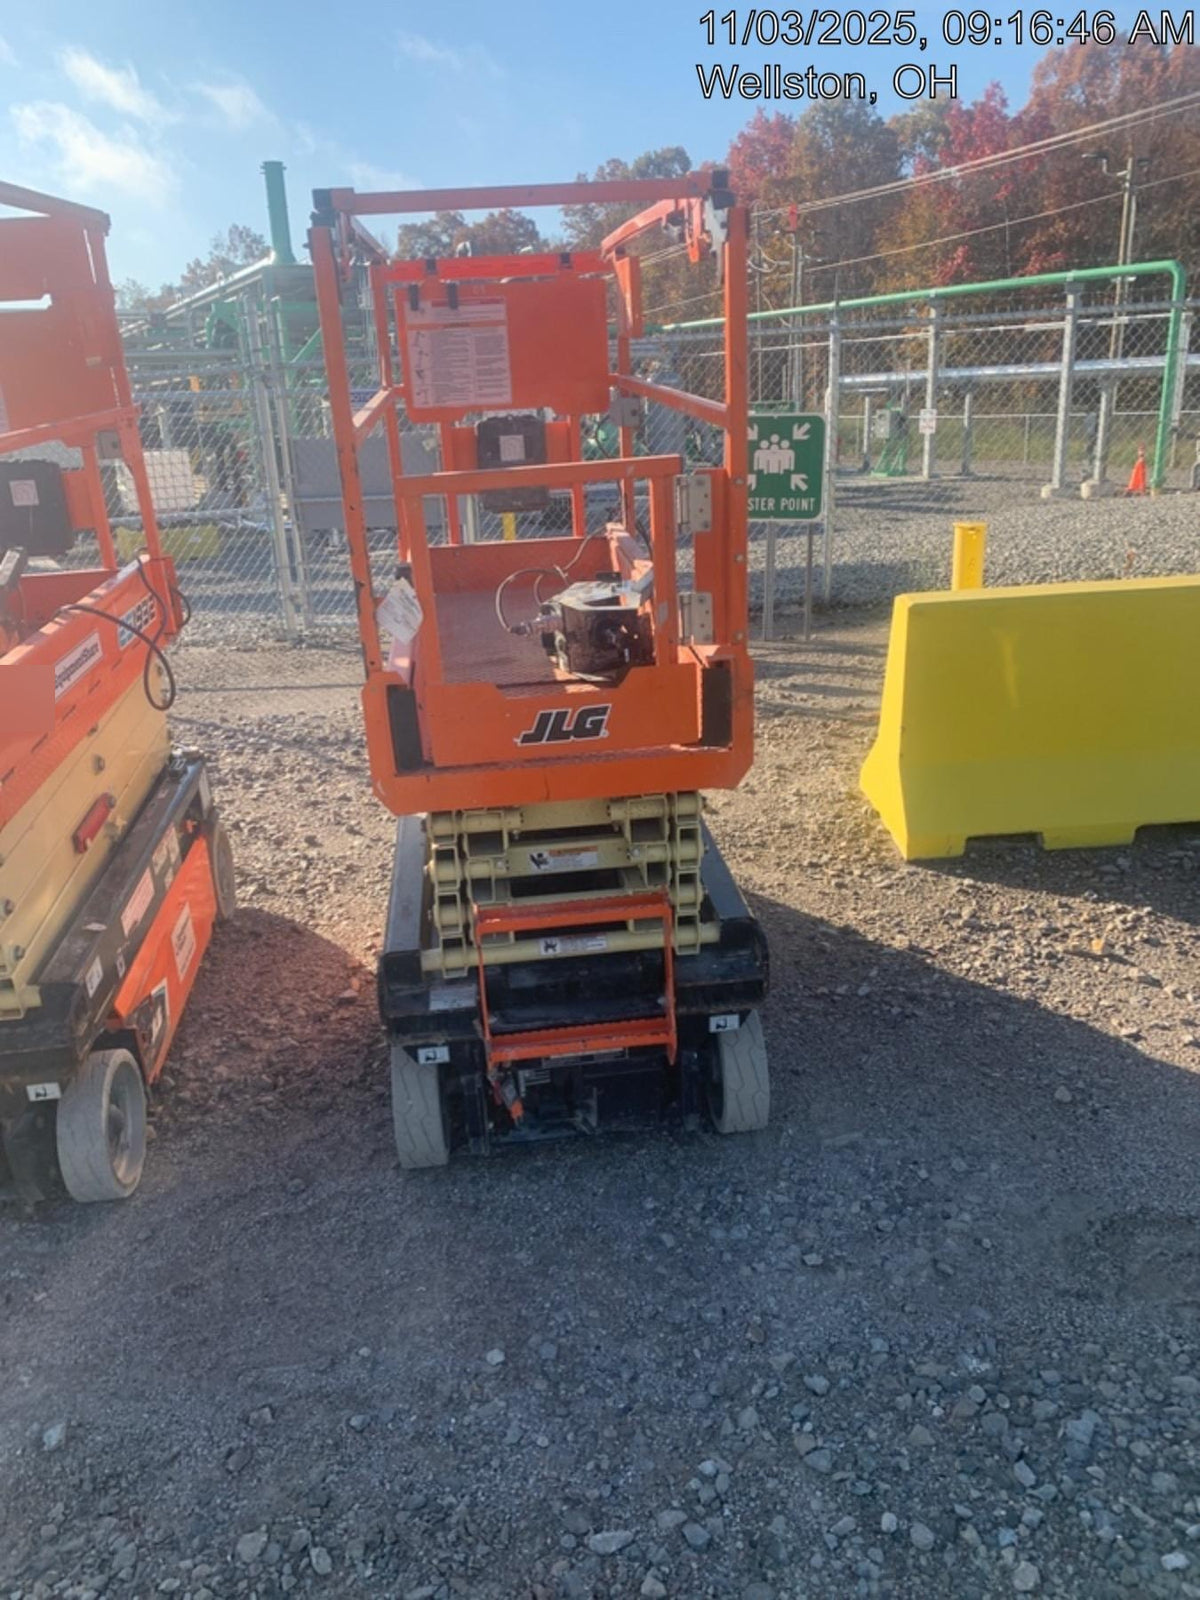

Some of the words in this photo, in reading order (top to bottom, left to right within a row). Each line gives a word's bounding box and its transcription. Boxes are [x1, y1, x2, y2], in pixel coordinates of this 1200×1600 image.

[747, 497, 775, 511] STER
[780, 497, 815, 511] POINT
[518, 704, 612, 746] JLG
